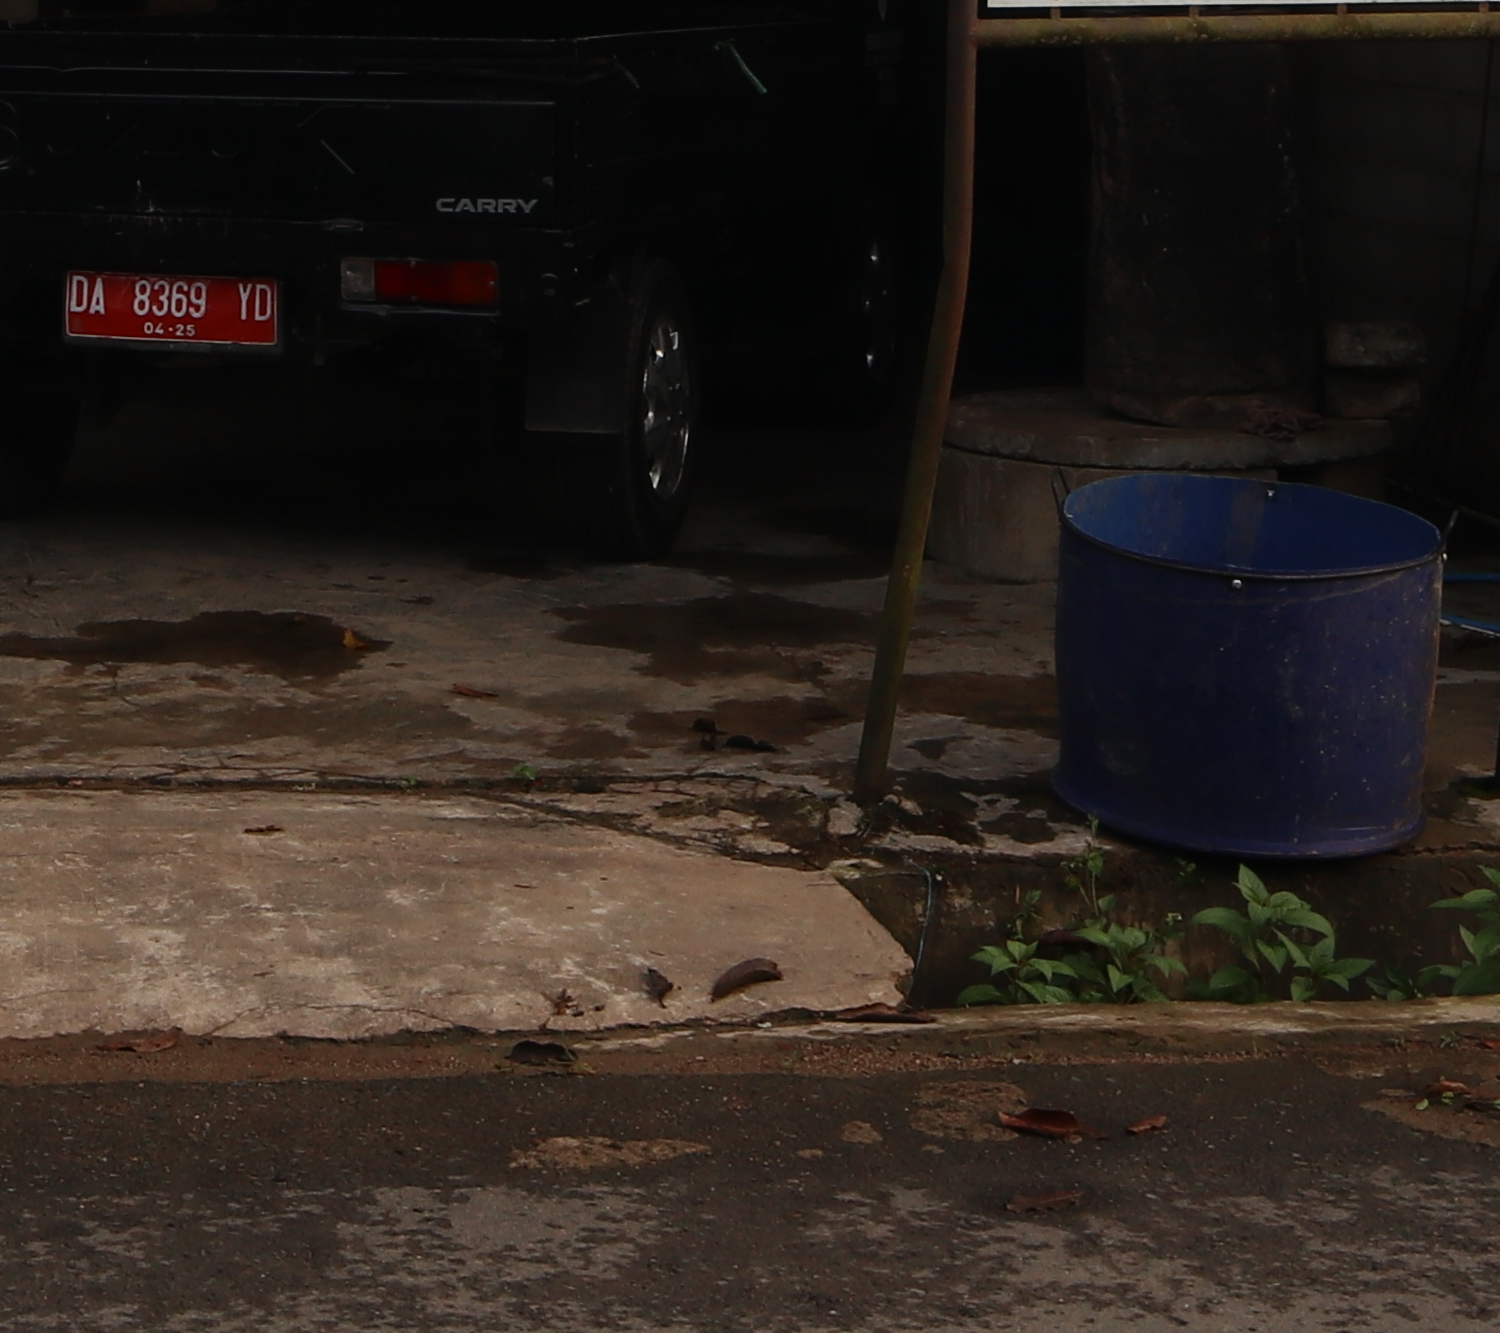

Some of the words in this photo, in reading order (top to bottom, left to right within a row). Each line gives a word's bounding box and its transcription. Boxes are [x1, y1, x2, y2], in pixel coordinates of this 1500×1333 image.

[436, 197, 538, 214] CARRY
[70, 275, 105, 315] DA
[133, 279, 207, 318] 8369
[238, 283, 273, 321] YD
